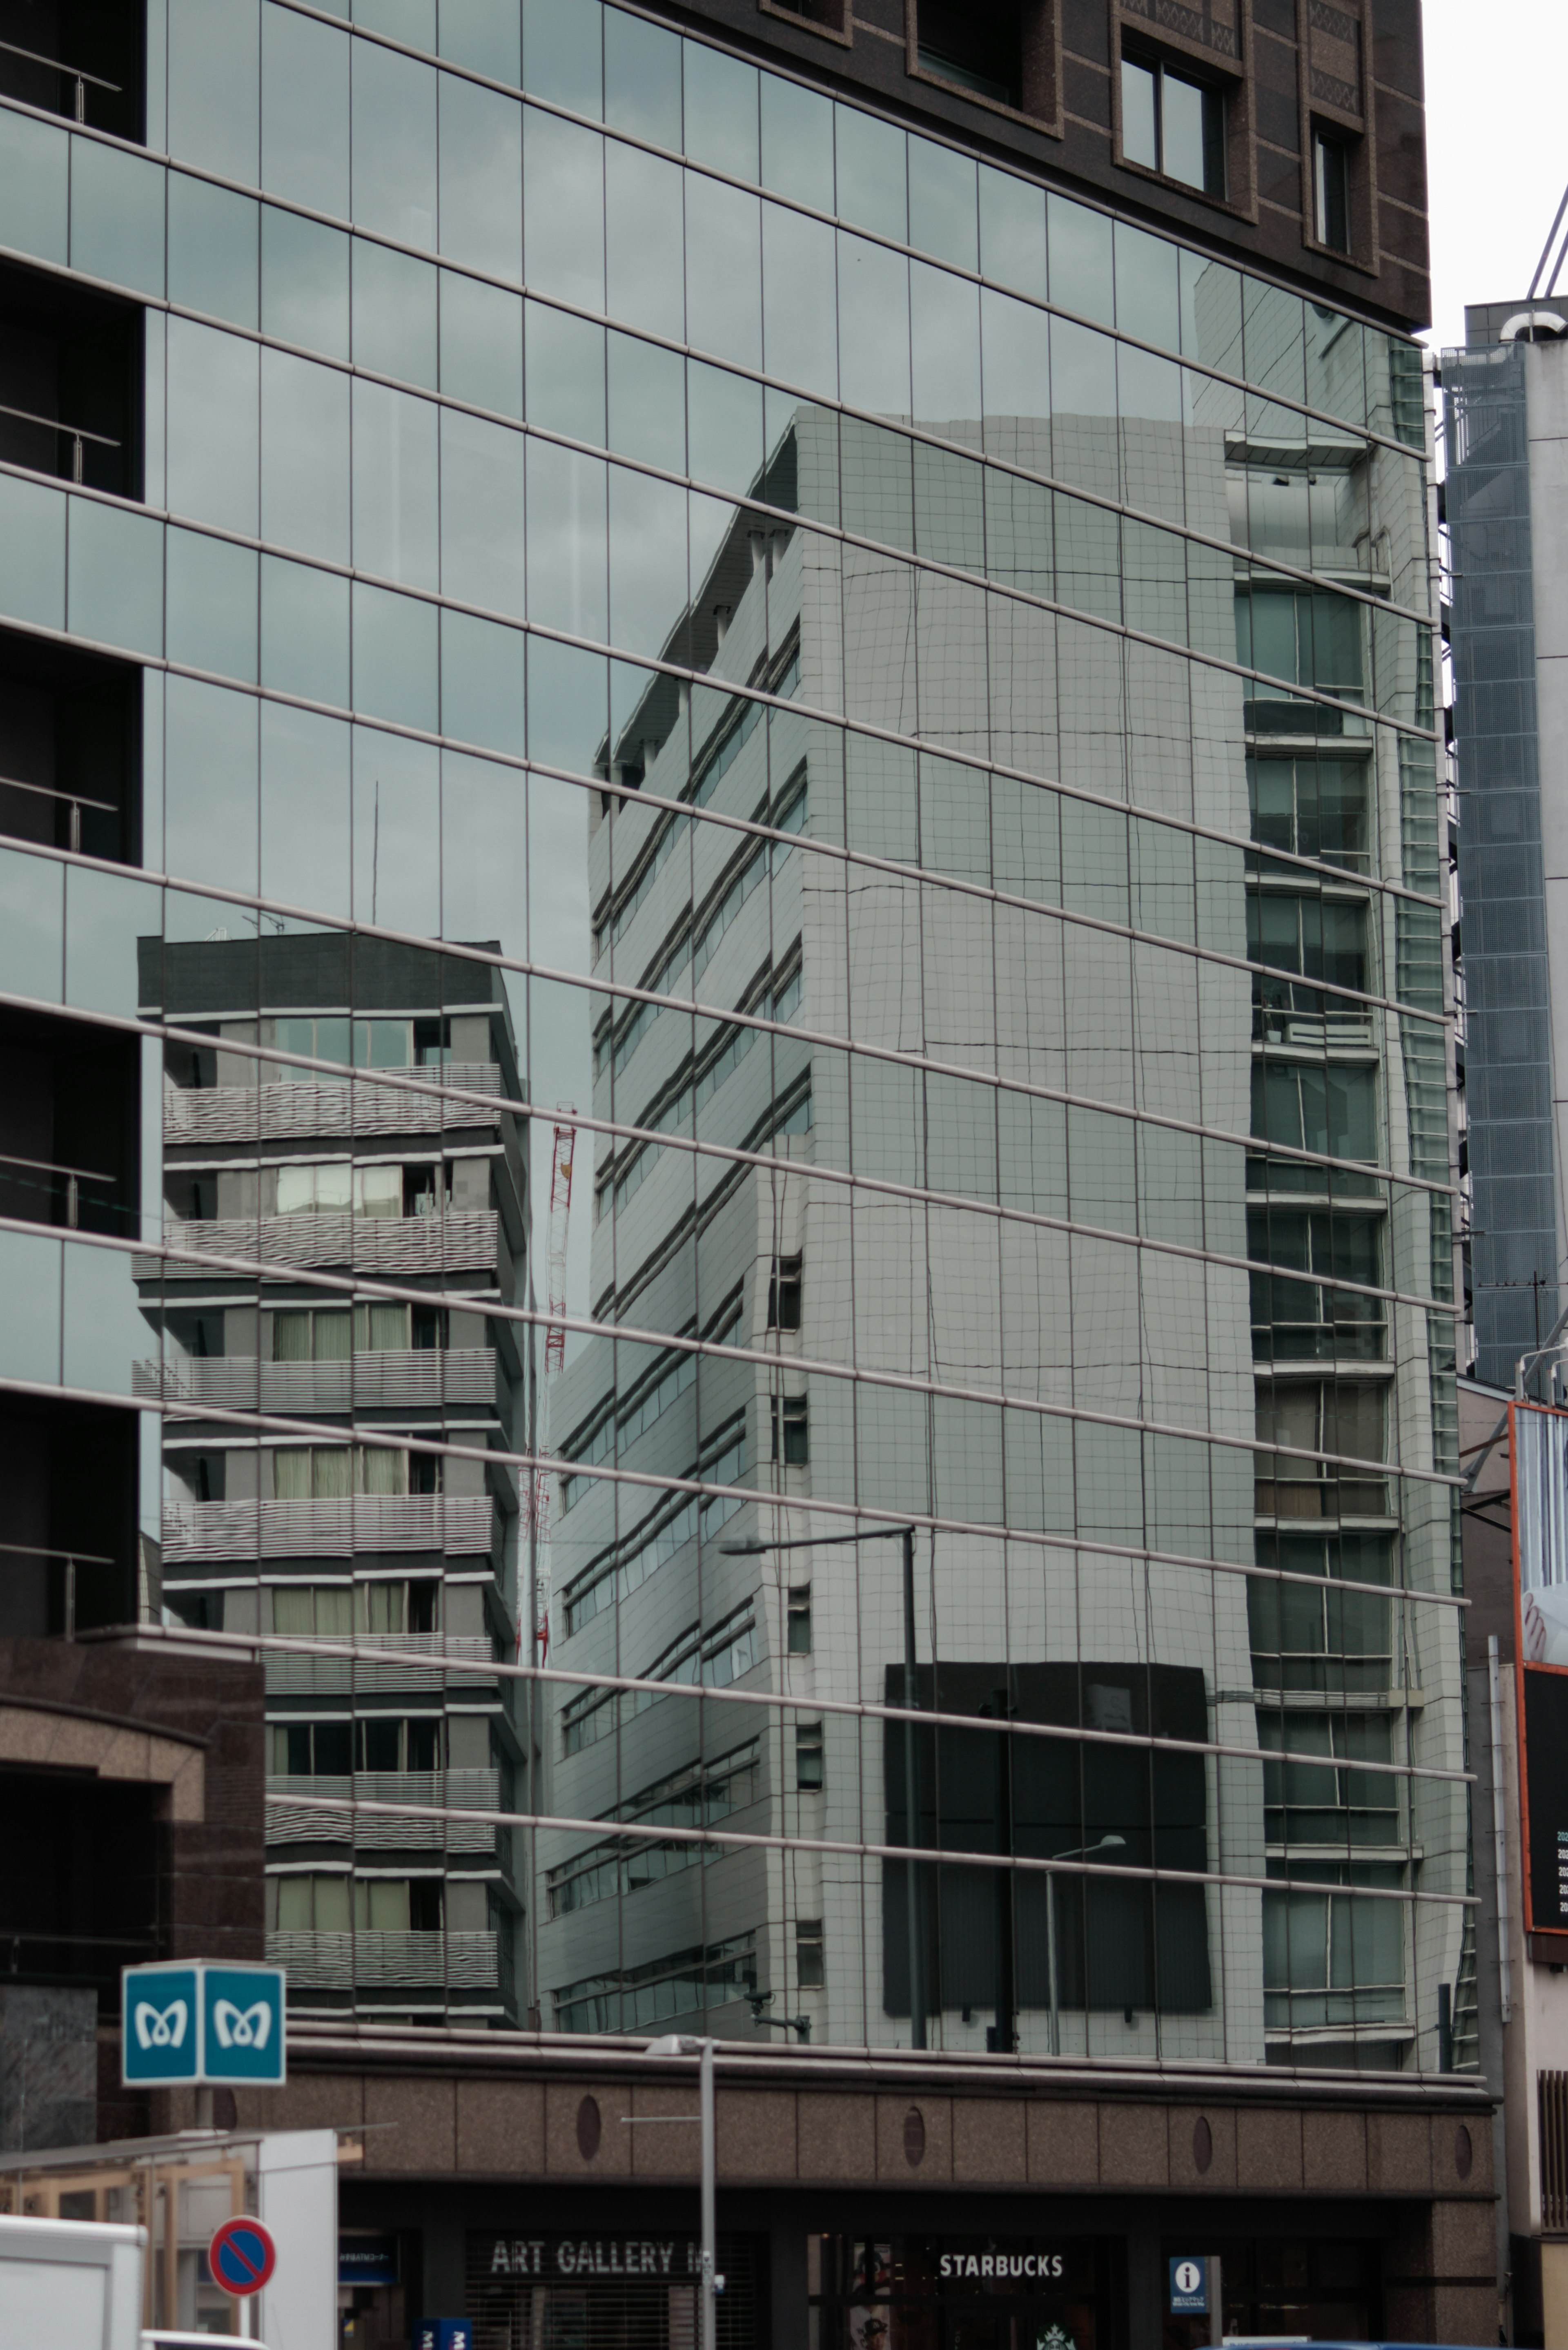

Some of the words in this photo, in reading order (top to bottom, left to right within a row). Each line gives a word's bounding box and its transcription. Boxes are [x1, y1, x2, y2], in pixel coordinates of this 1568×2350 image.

[491, 2241, 545, 2273] ART
[557, 2241, 675, 2273] GALLERY
[940, 2254, 1062, 2276] STARBUCKS
